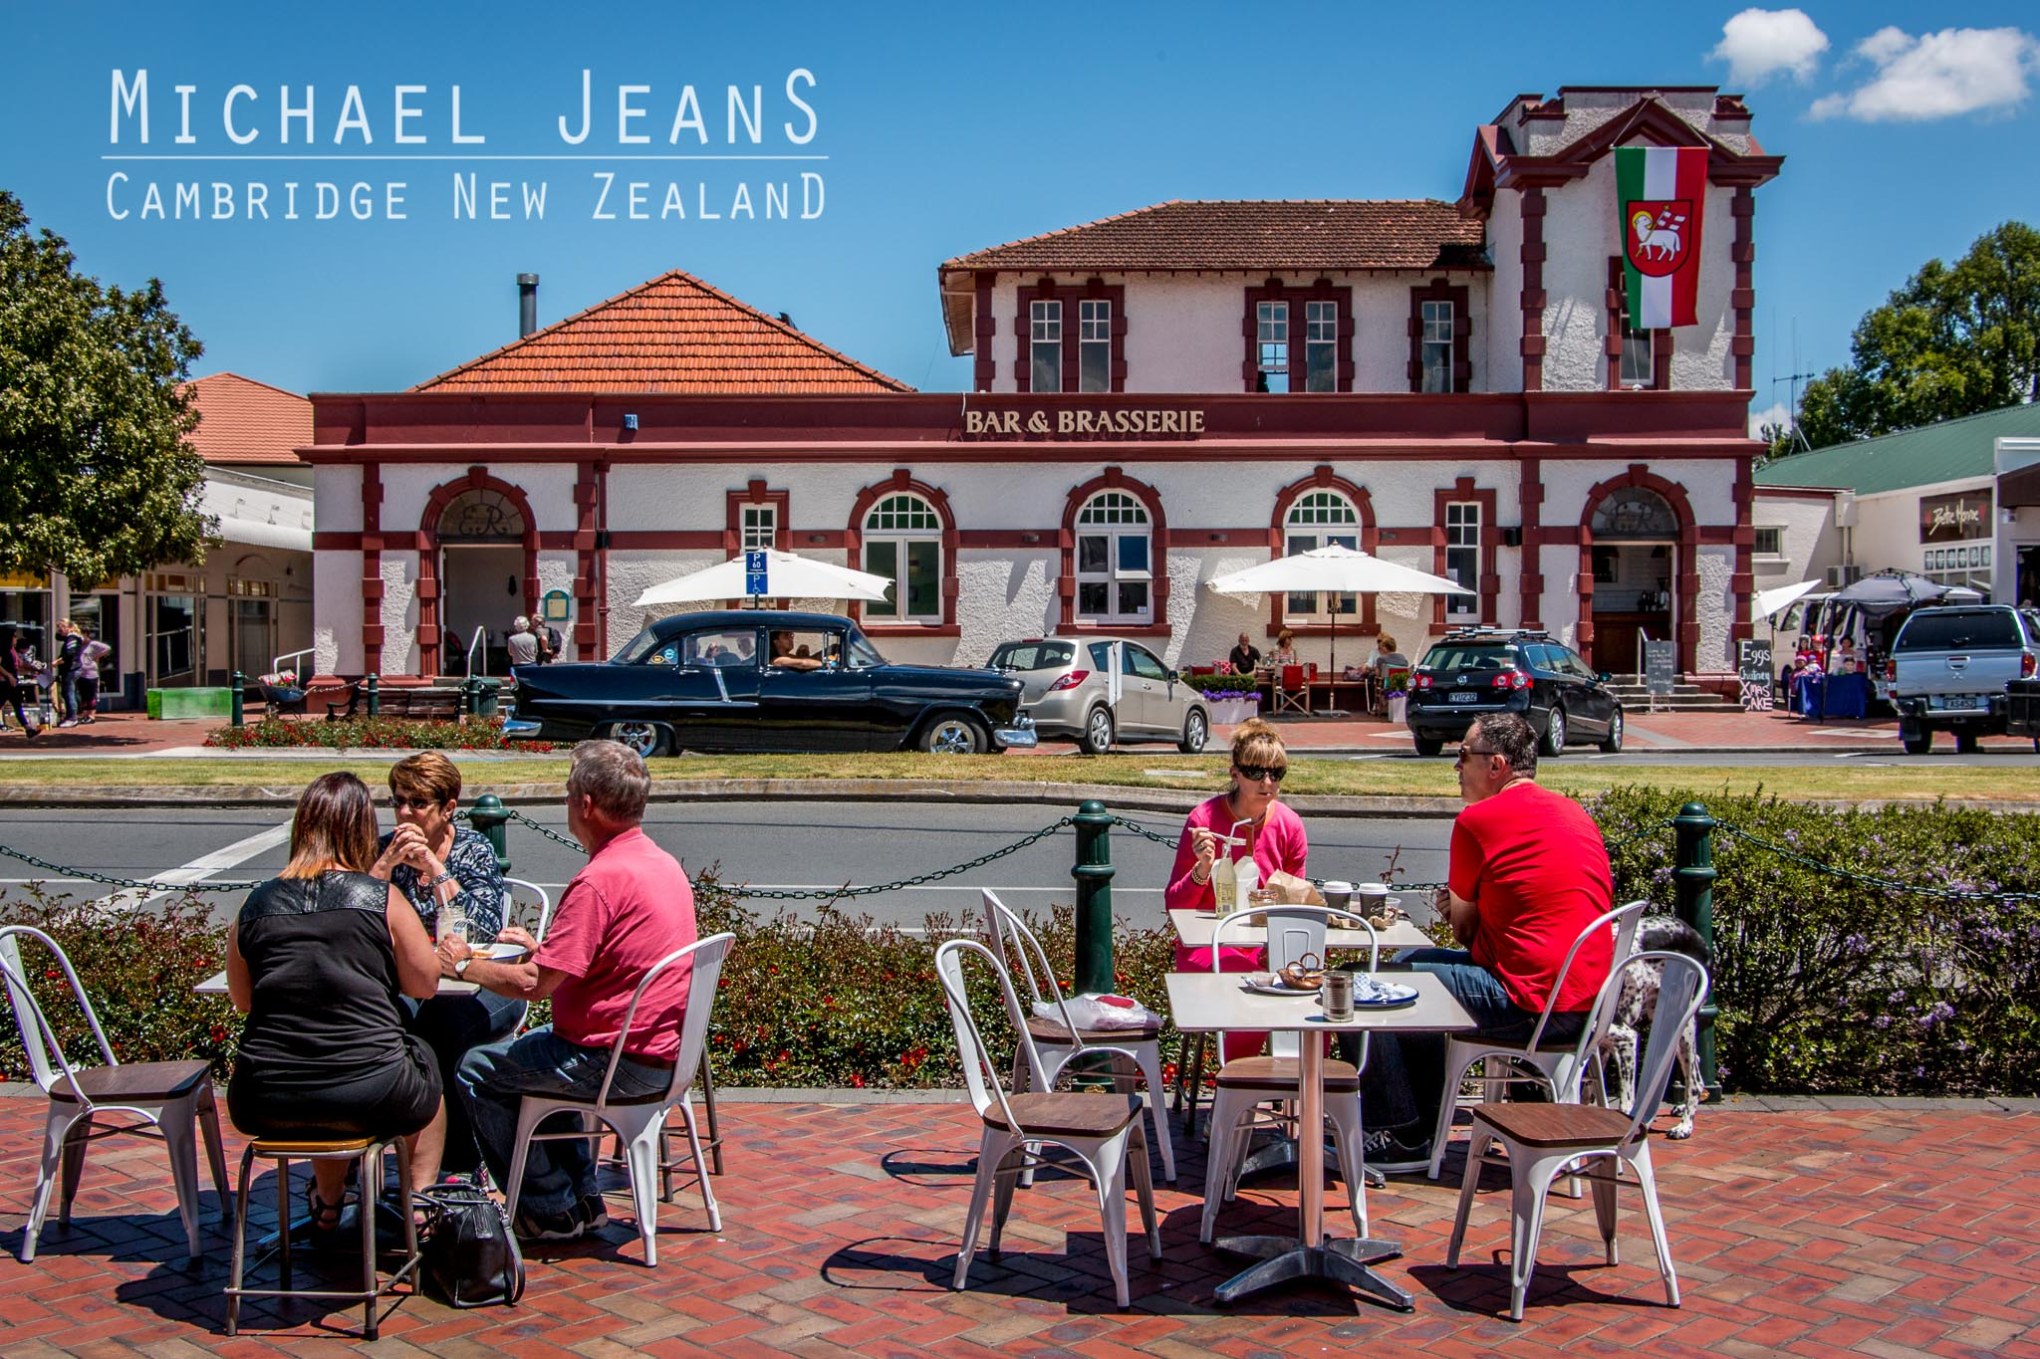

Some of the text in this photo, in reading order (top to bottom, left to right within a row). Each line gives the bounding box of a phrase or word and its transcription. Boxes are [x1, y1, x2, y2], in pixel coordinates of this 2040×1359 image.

[966, 410, 1206, 433] BAR & BRASSERIE
[752, 561, 761, 569] 60
[753, 553, 761, 562] P
[753, 574, 761, 583] P
[1741, 640, 1771, 666] Eggs
[1738, 665, 1770, 687] Chutney
[1740, 695, 1773, 711] CAKE
